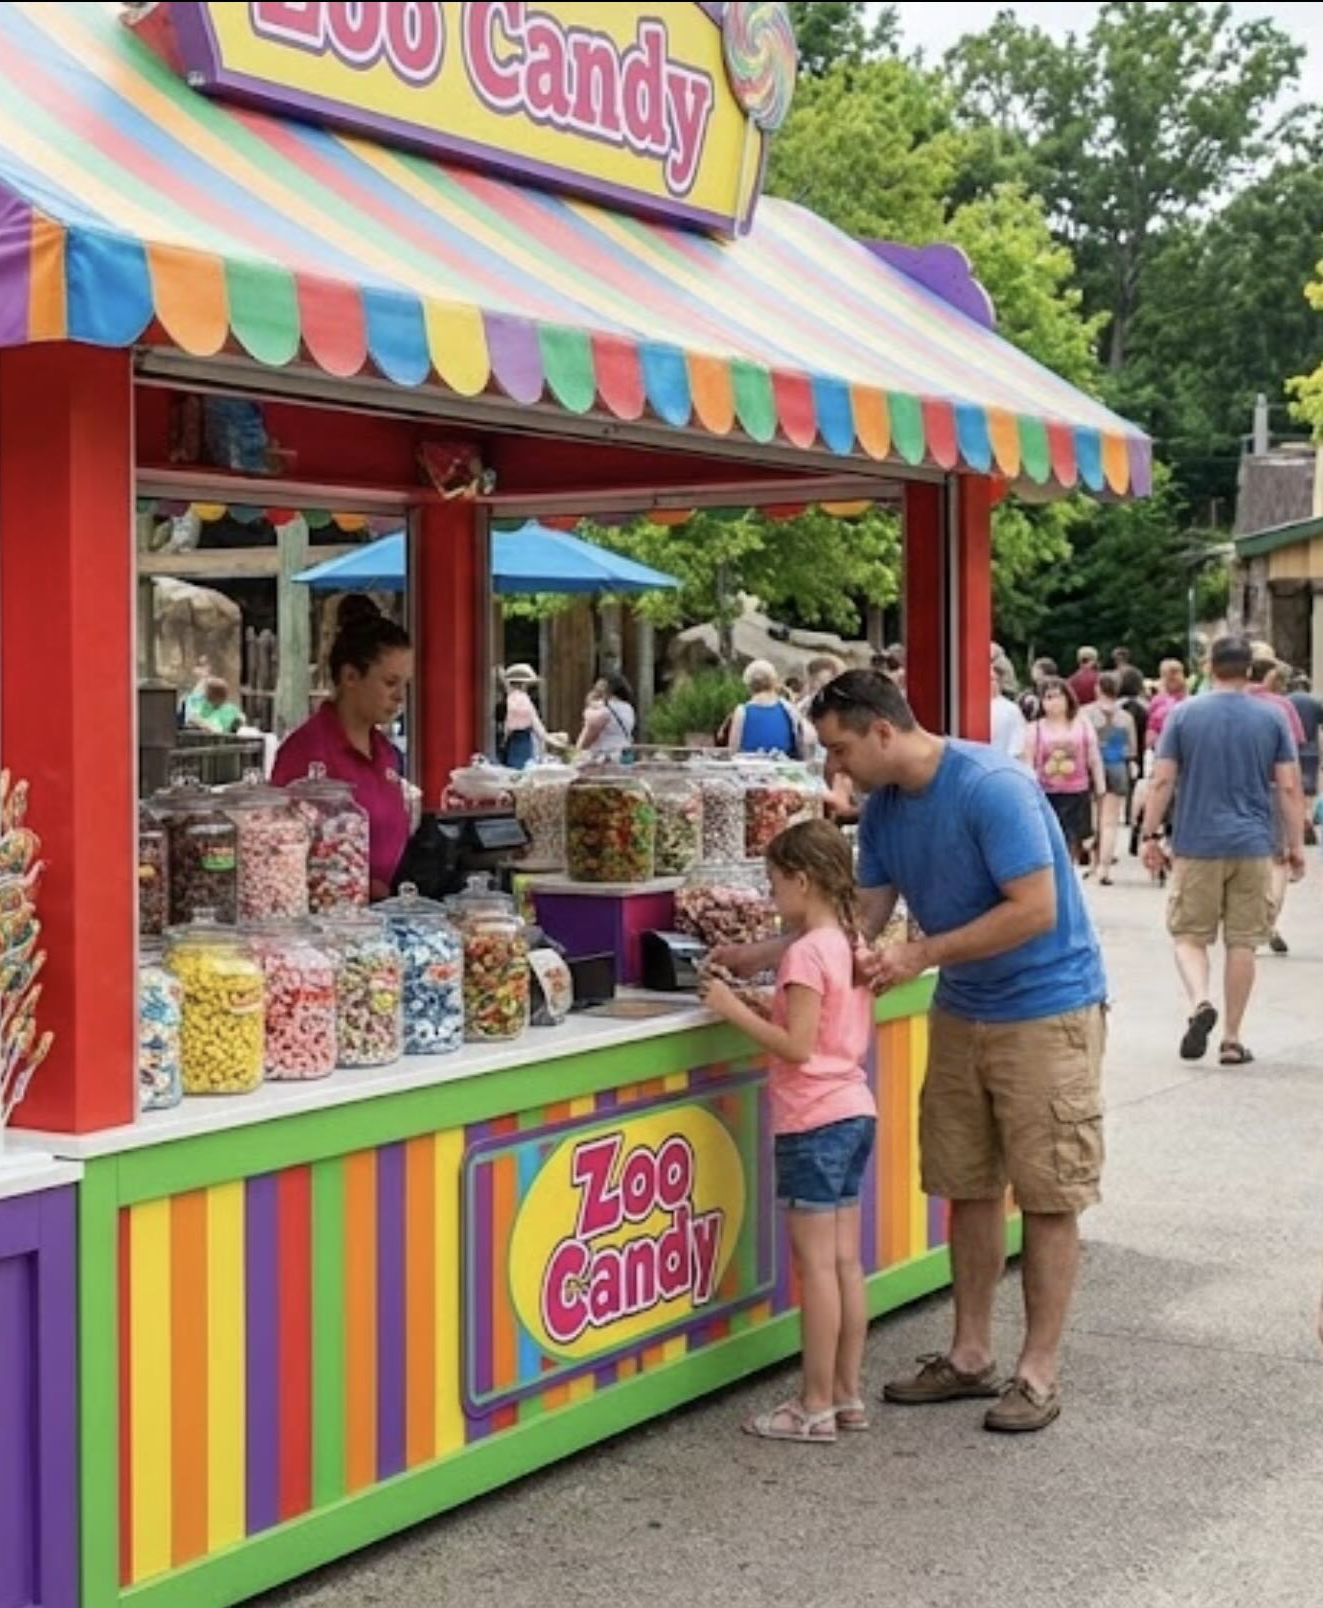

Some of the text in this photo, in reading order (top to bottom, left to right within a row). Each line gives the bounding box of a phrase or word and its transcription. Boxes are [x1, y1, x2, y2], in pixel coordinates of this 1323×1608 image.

[463, 2, 711, 191] Candy
[572, 1135, 693, 1240] Zoo
[544, 1202, 722, 1341] Candy
